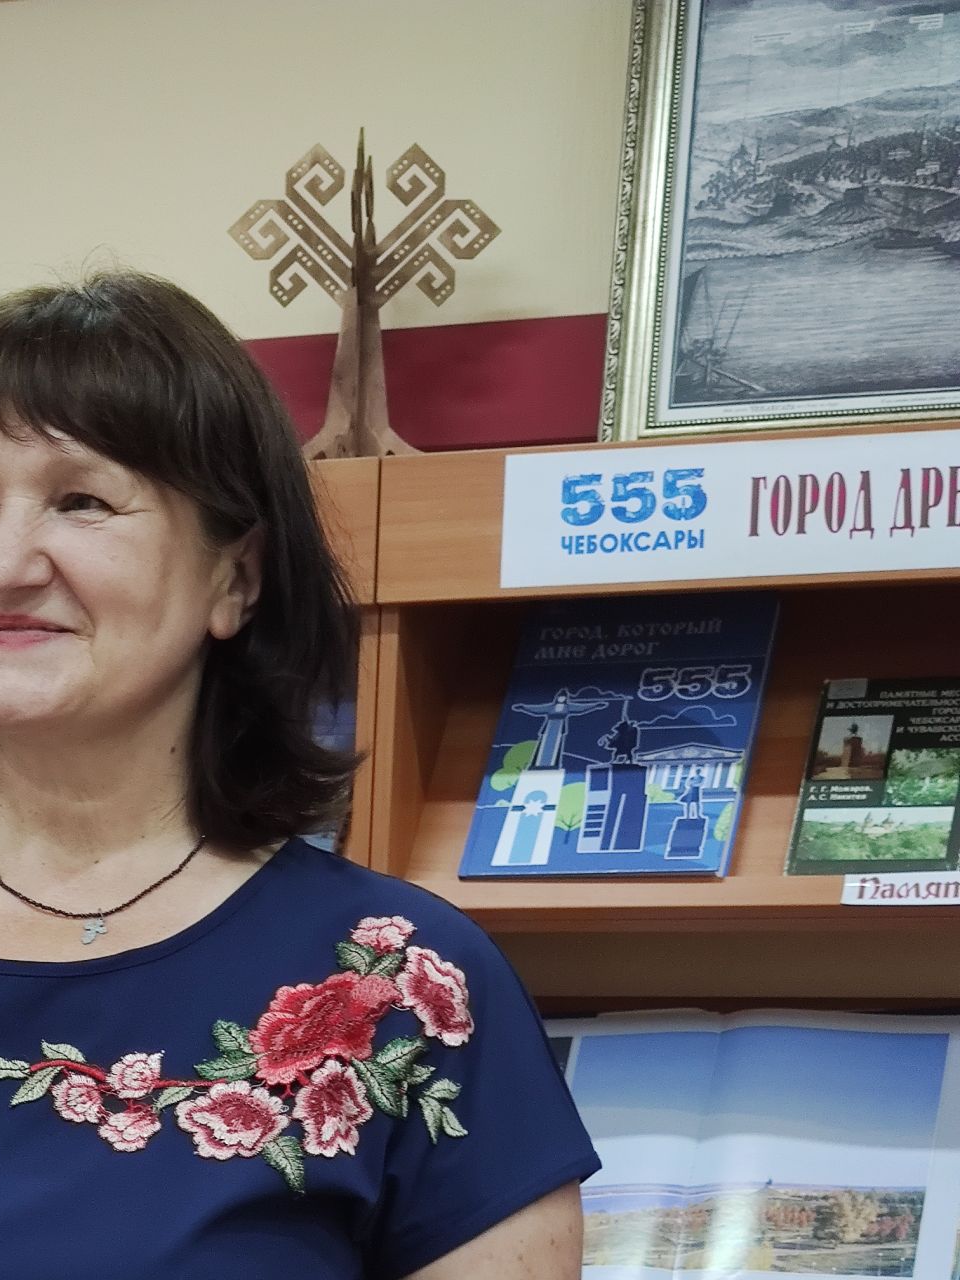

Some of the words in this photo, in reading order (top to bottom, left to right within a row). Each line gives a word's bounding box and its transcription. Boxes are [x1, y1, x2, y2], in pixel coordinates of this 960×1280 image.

[560, 467, 708, 527] 555
[748, 471, 876, 540] ГОРОД
[560, 528, 705, 556] ЧЕБОКСАРЫ
[617, 617, 722, 638] КОТОРЫЙ
[591, 641, 660, 661] ДОРОГ
[637, 664, 752, 701] 555
